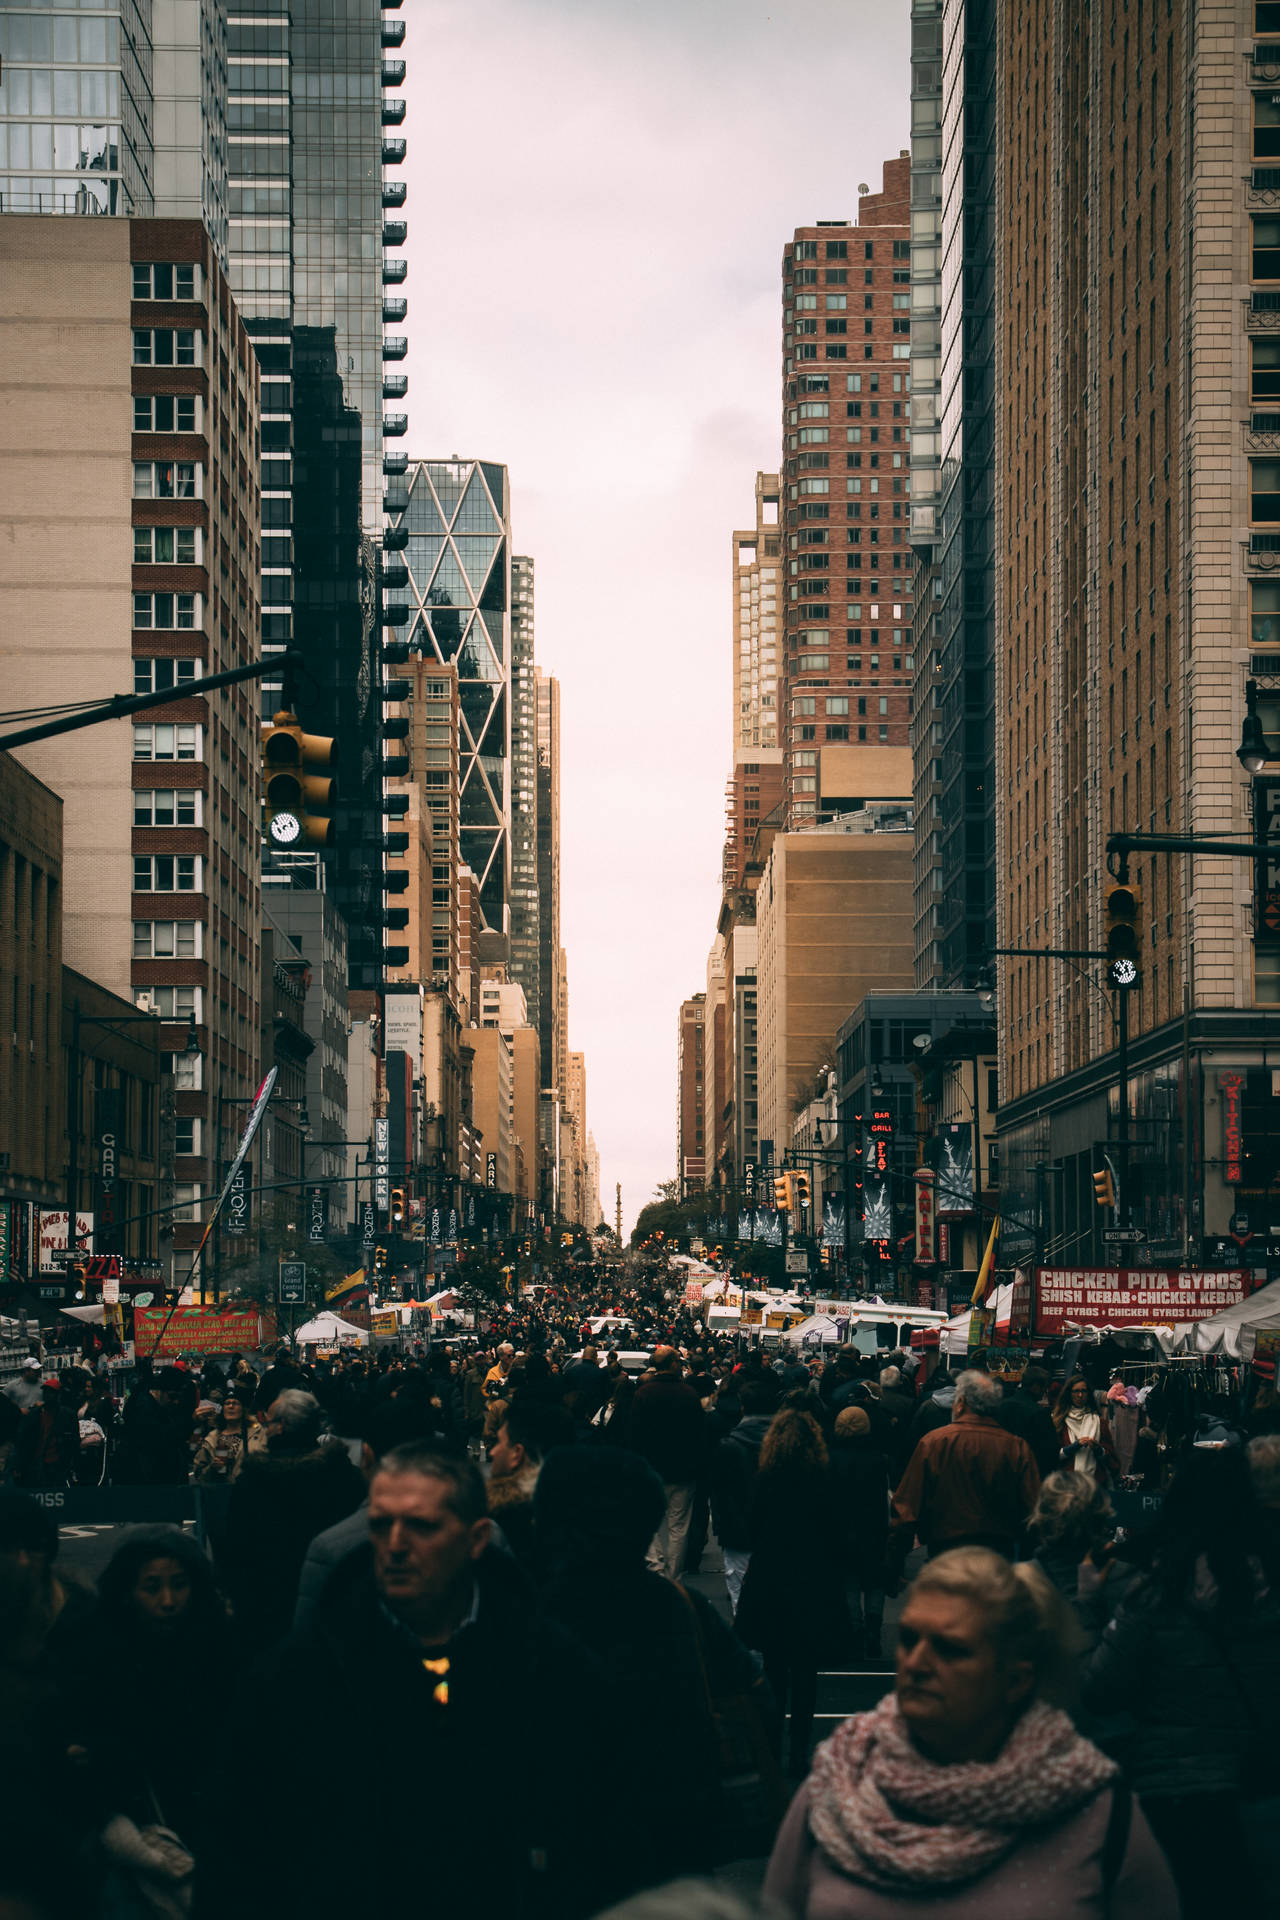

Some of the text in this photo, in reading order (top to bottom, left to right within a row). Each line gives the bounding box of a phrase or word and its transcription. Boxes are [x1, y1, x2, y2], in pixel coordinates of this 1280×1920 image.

[1266, 788, 1280, 889] PAK
[377, 1122, 387, 1151] NEW
[1226, 1086, 1240, 1181] KITCHEN
[228, 1169, 248, 1228] FROZEN
[310, 1194, 326, 1240] FROZEN
[362, 1207, 376, 1246] FROZEN
[431, 1212, 440, 1241] FROZEN
[1128, 1231, 1141, 1240] WAY
[1040, 1270, 1243, 1290] CHICKEN PITA GYROS
[1040, 1289, 1082, 1303] SHISH
[1199, 1291, 1245, 1304] KEBAB
[1042, 1307, 1064, 1316] BEEF
[1066, 1307, 1099, 1316] GYROS
[1108, 1308, 1149, 1317] CHICKEN
[1152, 1308, 1184, 1317] GYROS
[1186, 1308, 1214, 1317] LAMB
